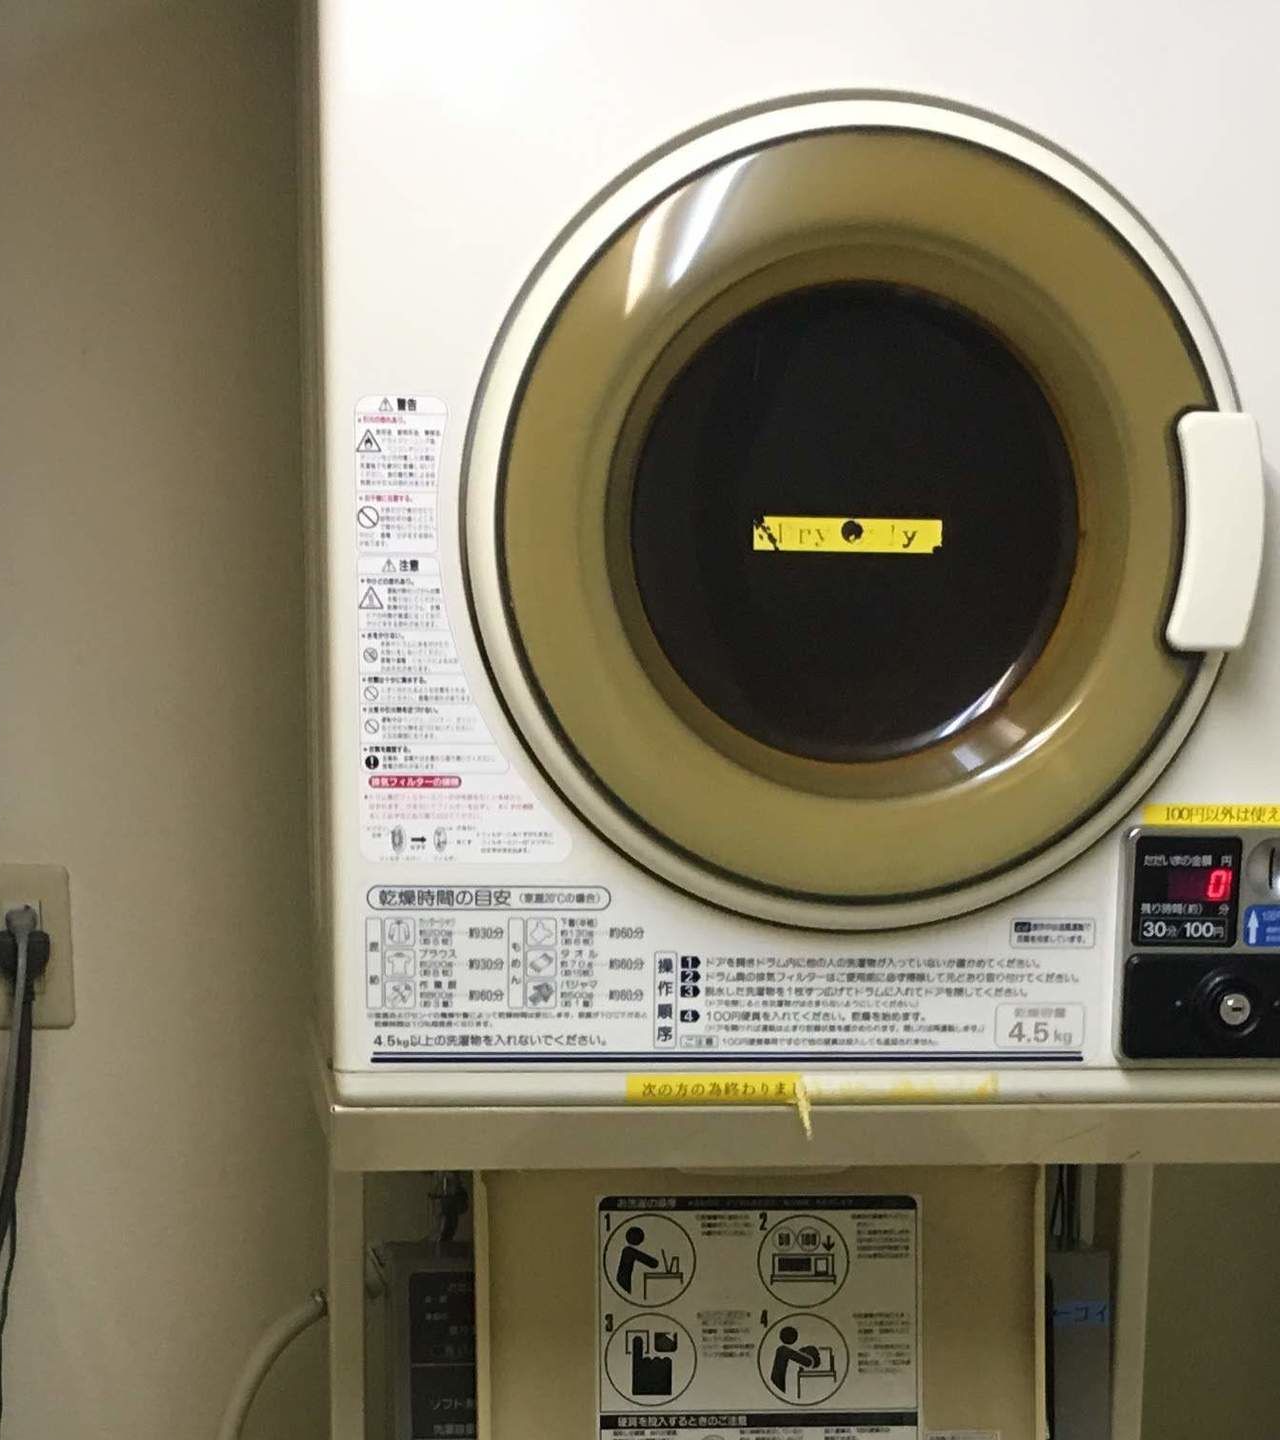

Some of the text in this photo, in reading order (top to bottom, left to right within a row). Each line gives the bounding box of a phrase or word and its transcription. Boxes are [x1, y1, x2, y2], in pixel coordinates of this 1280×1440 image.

[1207, 869, 1233, 898] 0
[379, 889, 512, 907] 乾燥時間の目安
[604, 1213, 611, 1233] 1
[759, 1212, 768, 1231] 2
[605, 1313, 614, 1333] 3
[760, 1309, 769, 1329] 4
